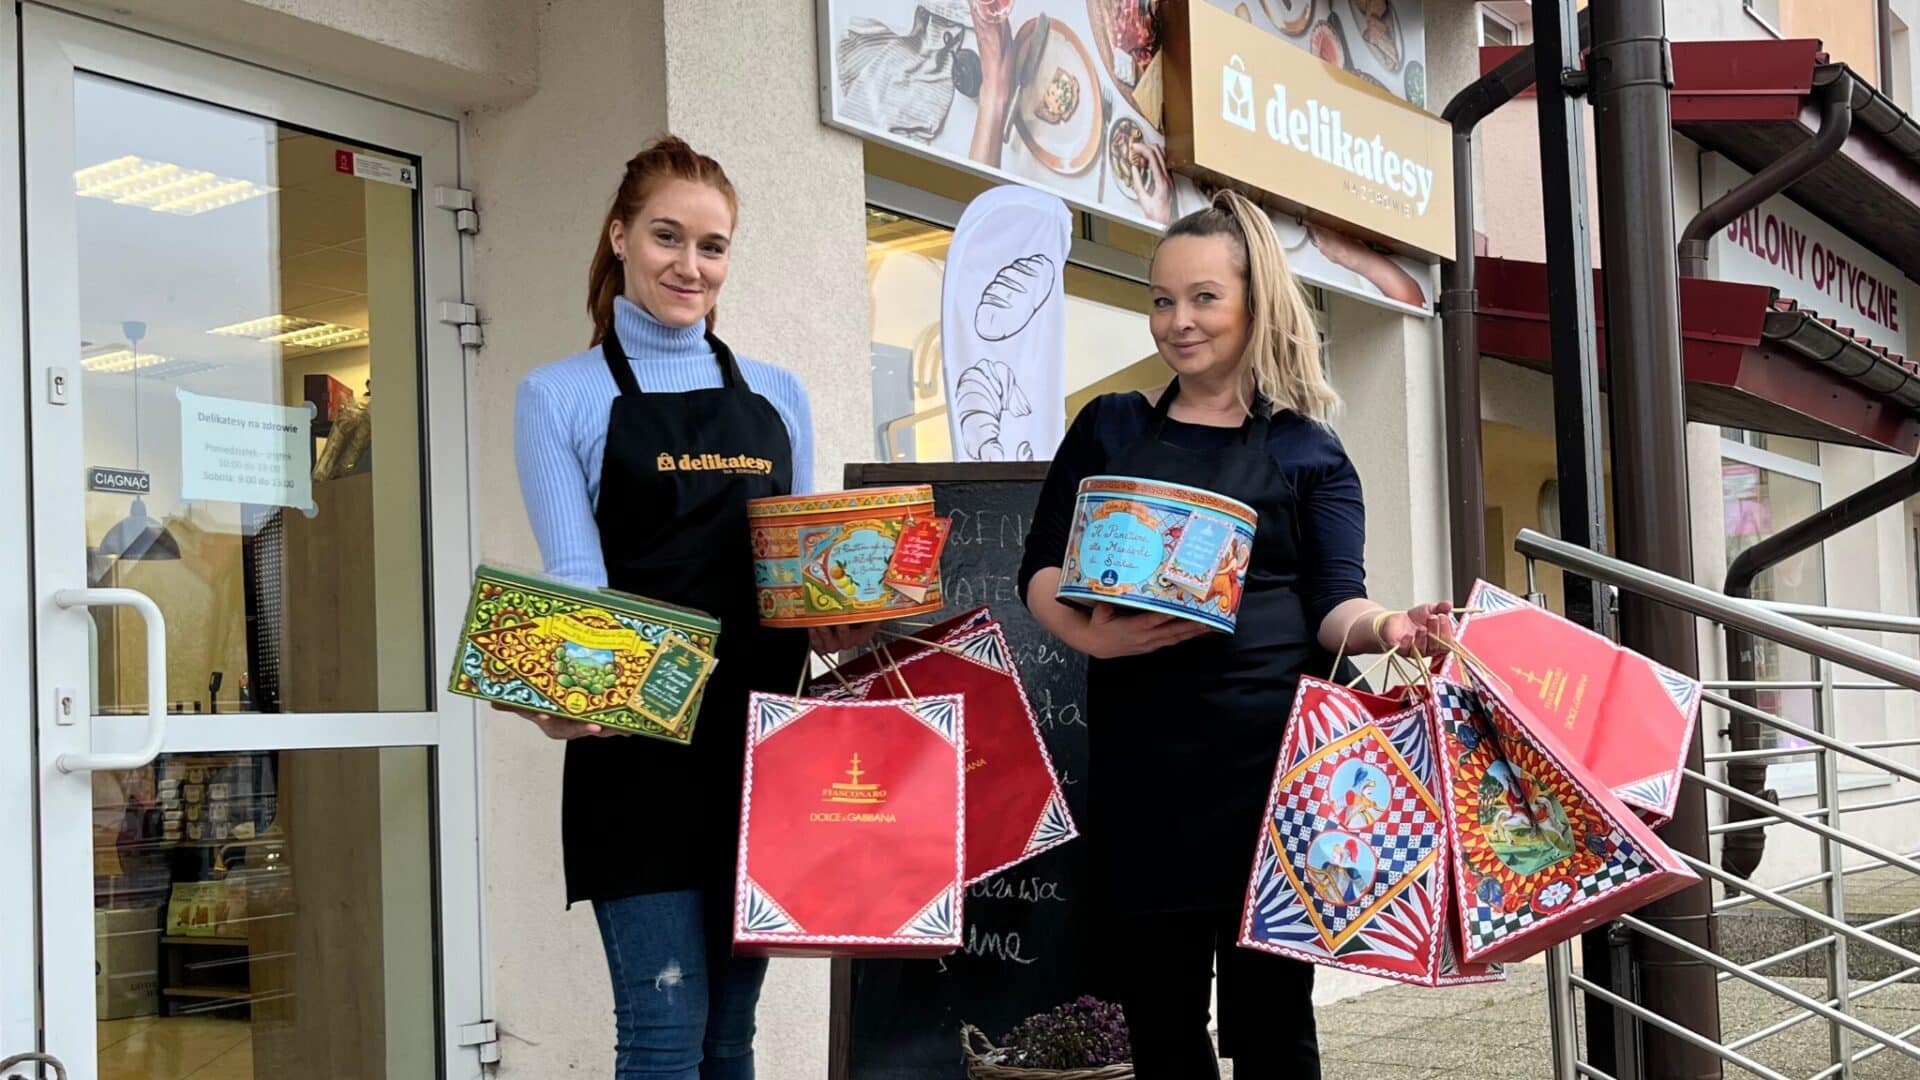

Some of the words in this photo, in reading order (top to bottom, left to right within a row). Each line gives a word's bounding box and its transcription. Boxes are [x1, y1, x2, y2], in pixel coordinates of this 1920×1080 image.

[1265, 83, 1433, 216] delikatesy
[1811, 242, 1899, 333] OPTYCZNE
[197, 412, 246, 429] Delikatesy
[262, 419, 298, 434] zdrowie
[678, 454, 773, 475] delikatesy
[95, 472, 149, 490] CIĄGNĄĆ
[822, 788, 887, 798] FIASCONARO
